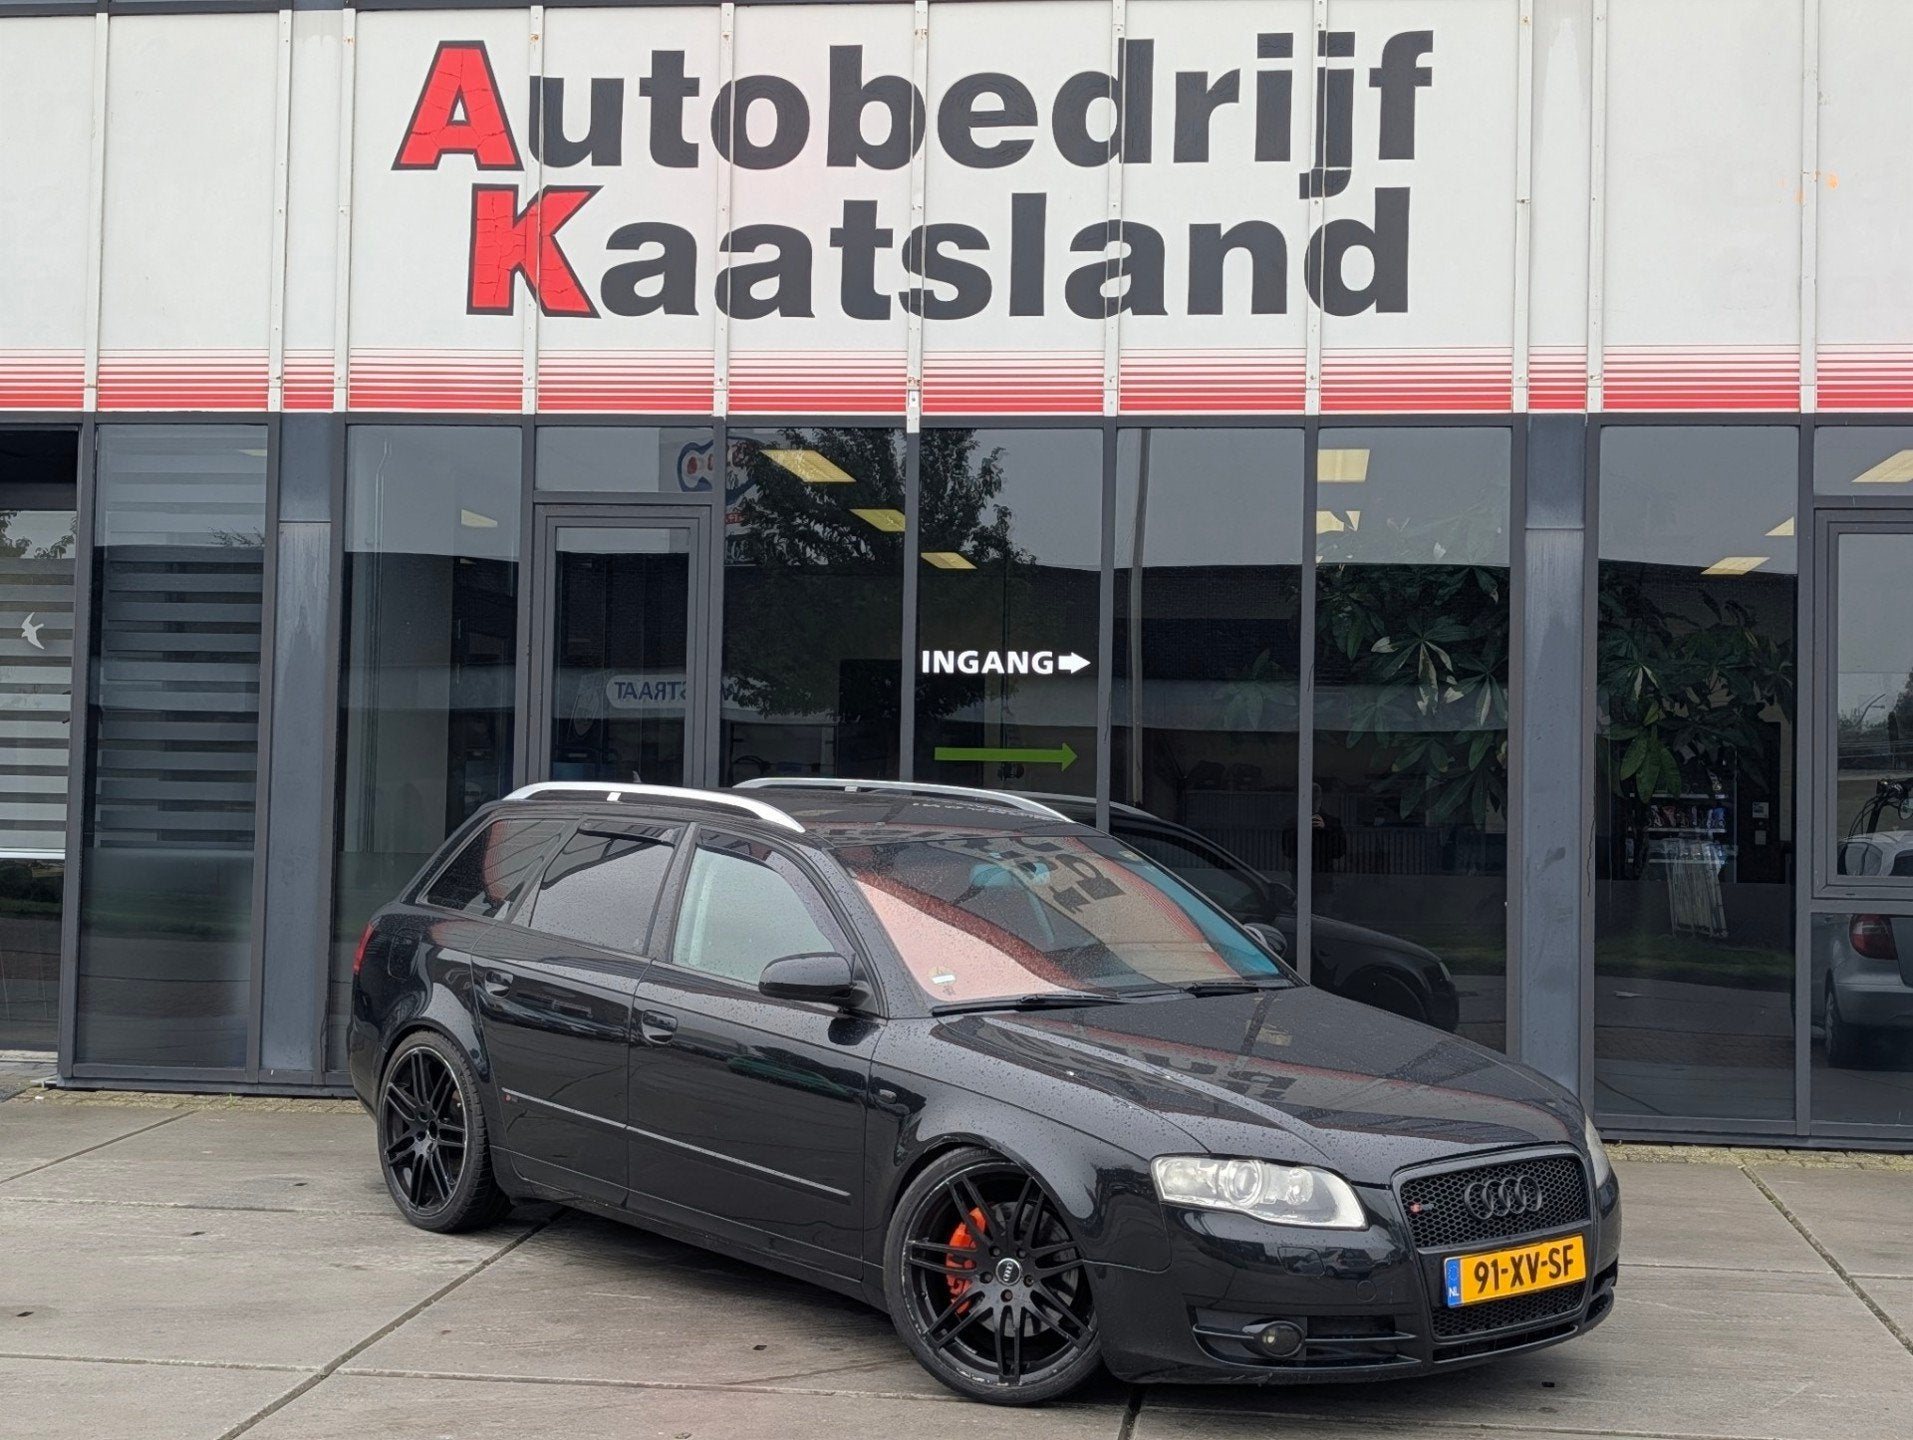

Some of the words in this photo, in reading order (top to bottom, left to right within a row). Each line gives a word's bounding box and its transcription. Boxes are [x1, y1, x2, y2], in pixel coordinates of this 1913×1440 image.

[391, 29, 1434, 200] Autobedrijf
[466, 184, 1411, 321] Kaatsland
[921, 650, 1054, 675] INGANG
[1448, 1286, 1460, 1298] NL
[1473, 1244, 1574, 1294] 91-XV-SF
